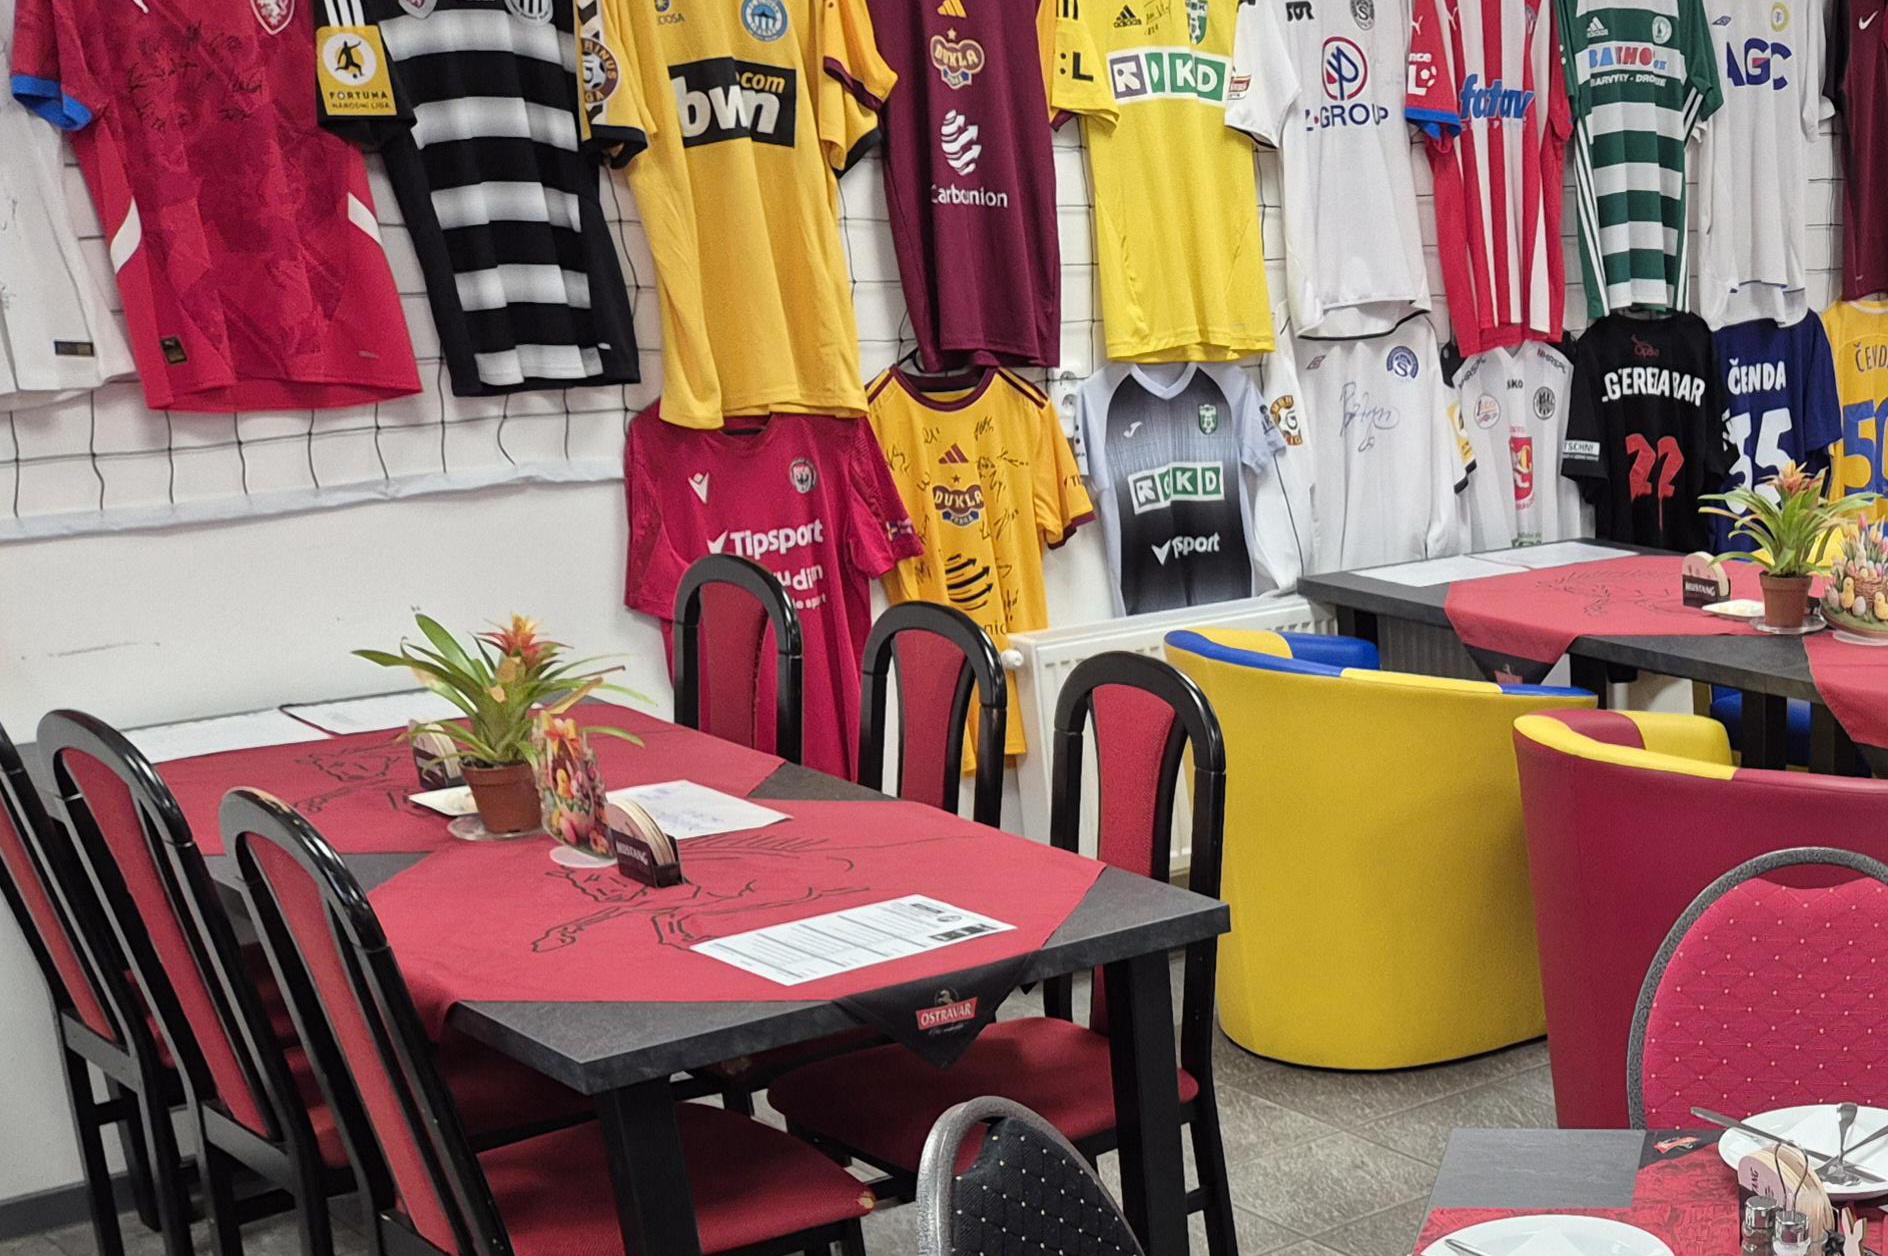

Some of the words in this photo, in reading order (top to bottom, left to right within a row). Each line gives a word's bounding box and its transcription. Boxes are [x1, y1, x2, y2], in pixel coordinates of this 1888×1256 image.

[329, 91, 388, 100] FORTUNA
[671, 76, 780, 138] bwn
[1727, 358, 1787, 396] ČENDA
[1625, 433, 1685, 503] 22
[934, 490, 984, 506] DUKLA
[729, 518, 824, 560] Tipsport
[920, 1002, 972, 1026] OSTRAVAR
